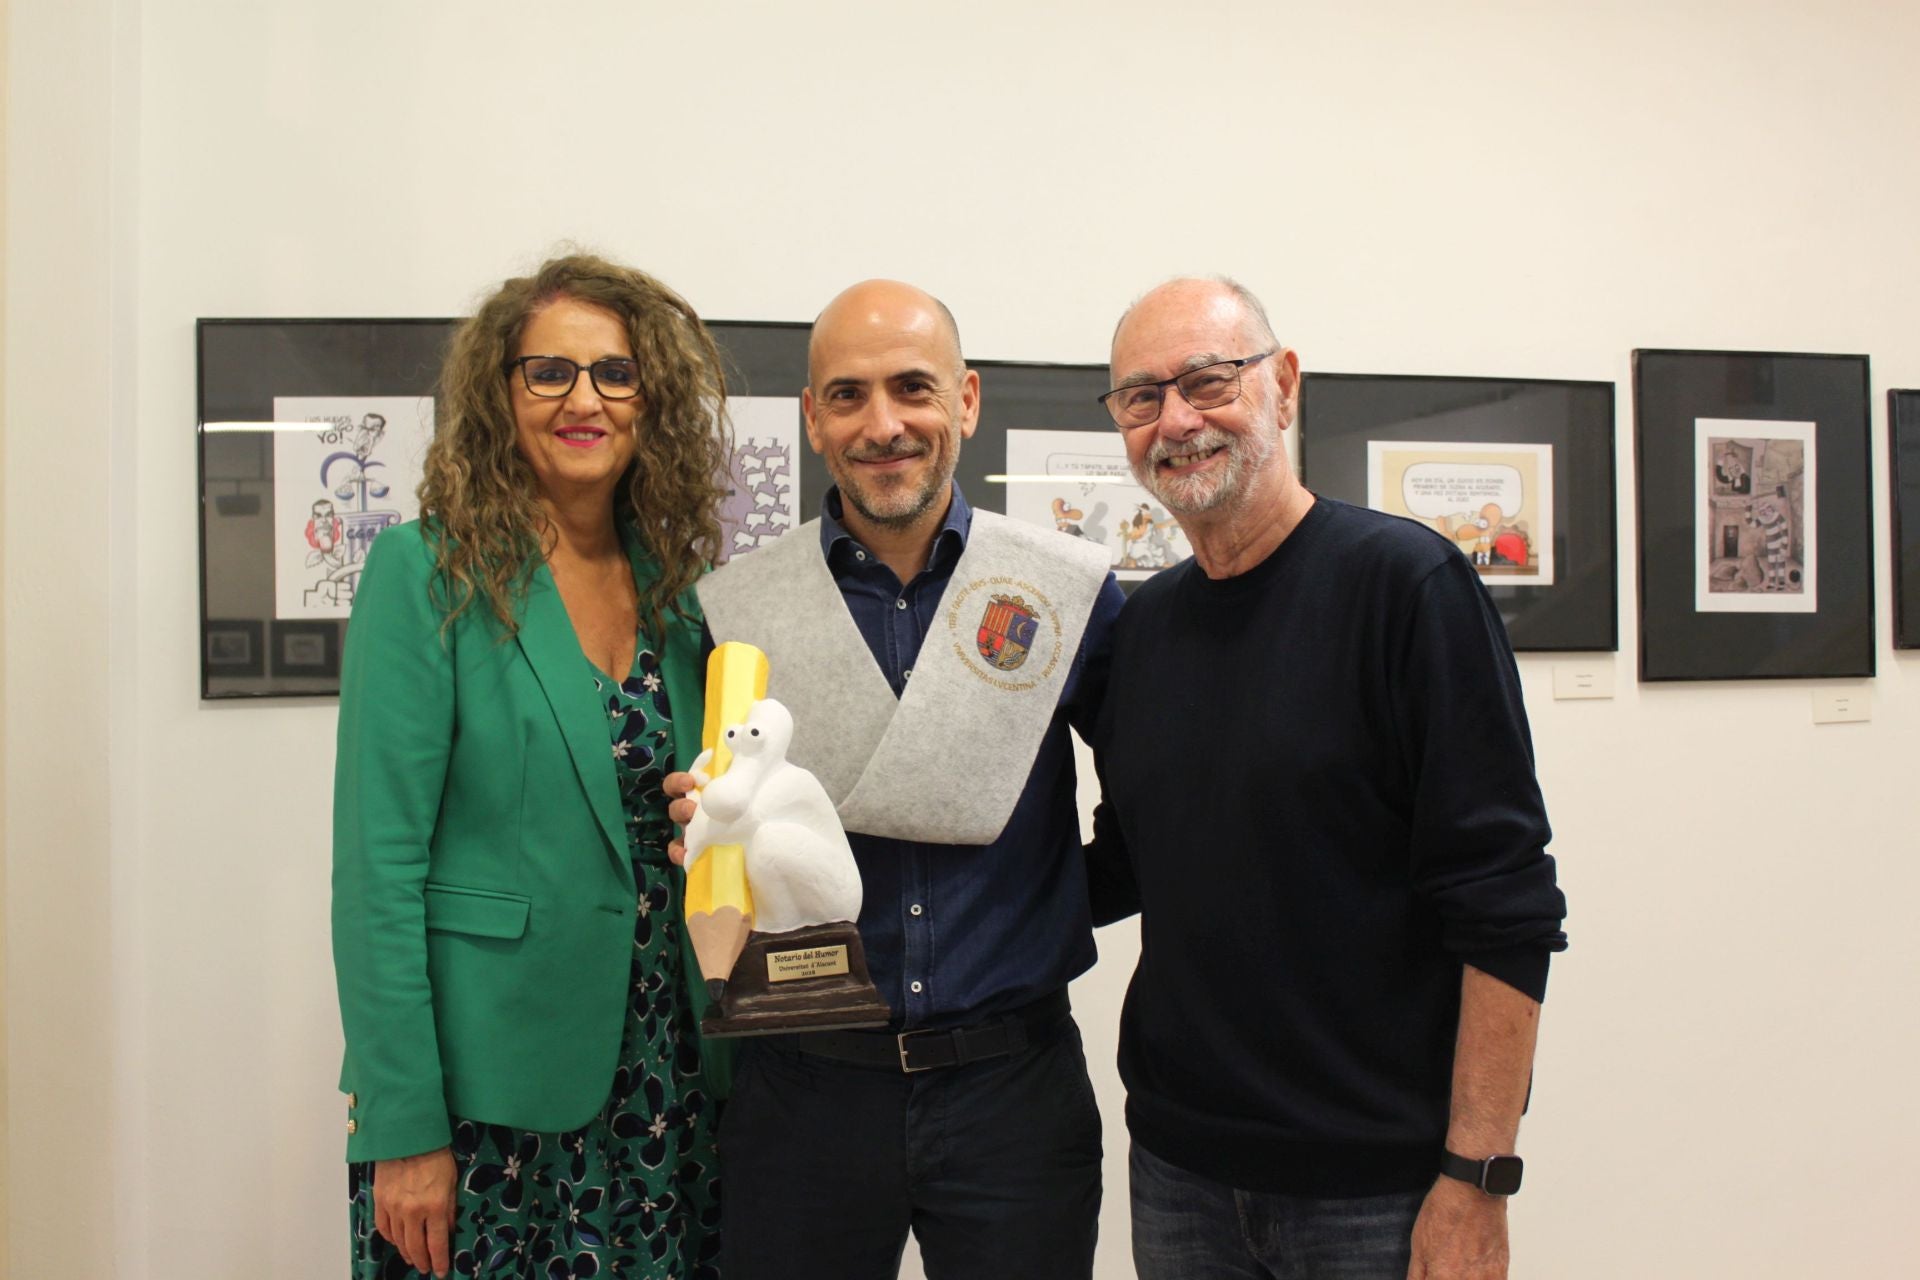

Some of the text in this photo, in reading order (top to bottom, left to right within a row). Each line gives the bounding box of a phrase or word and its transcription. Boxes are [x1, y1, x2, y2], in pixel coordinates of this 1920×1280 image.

[317, 431, 343, 444] YO!
[774, 950, 839, 963] Notario del Humor
